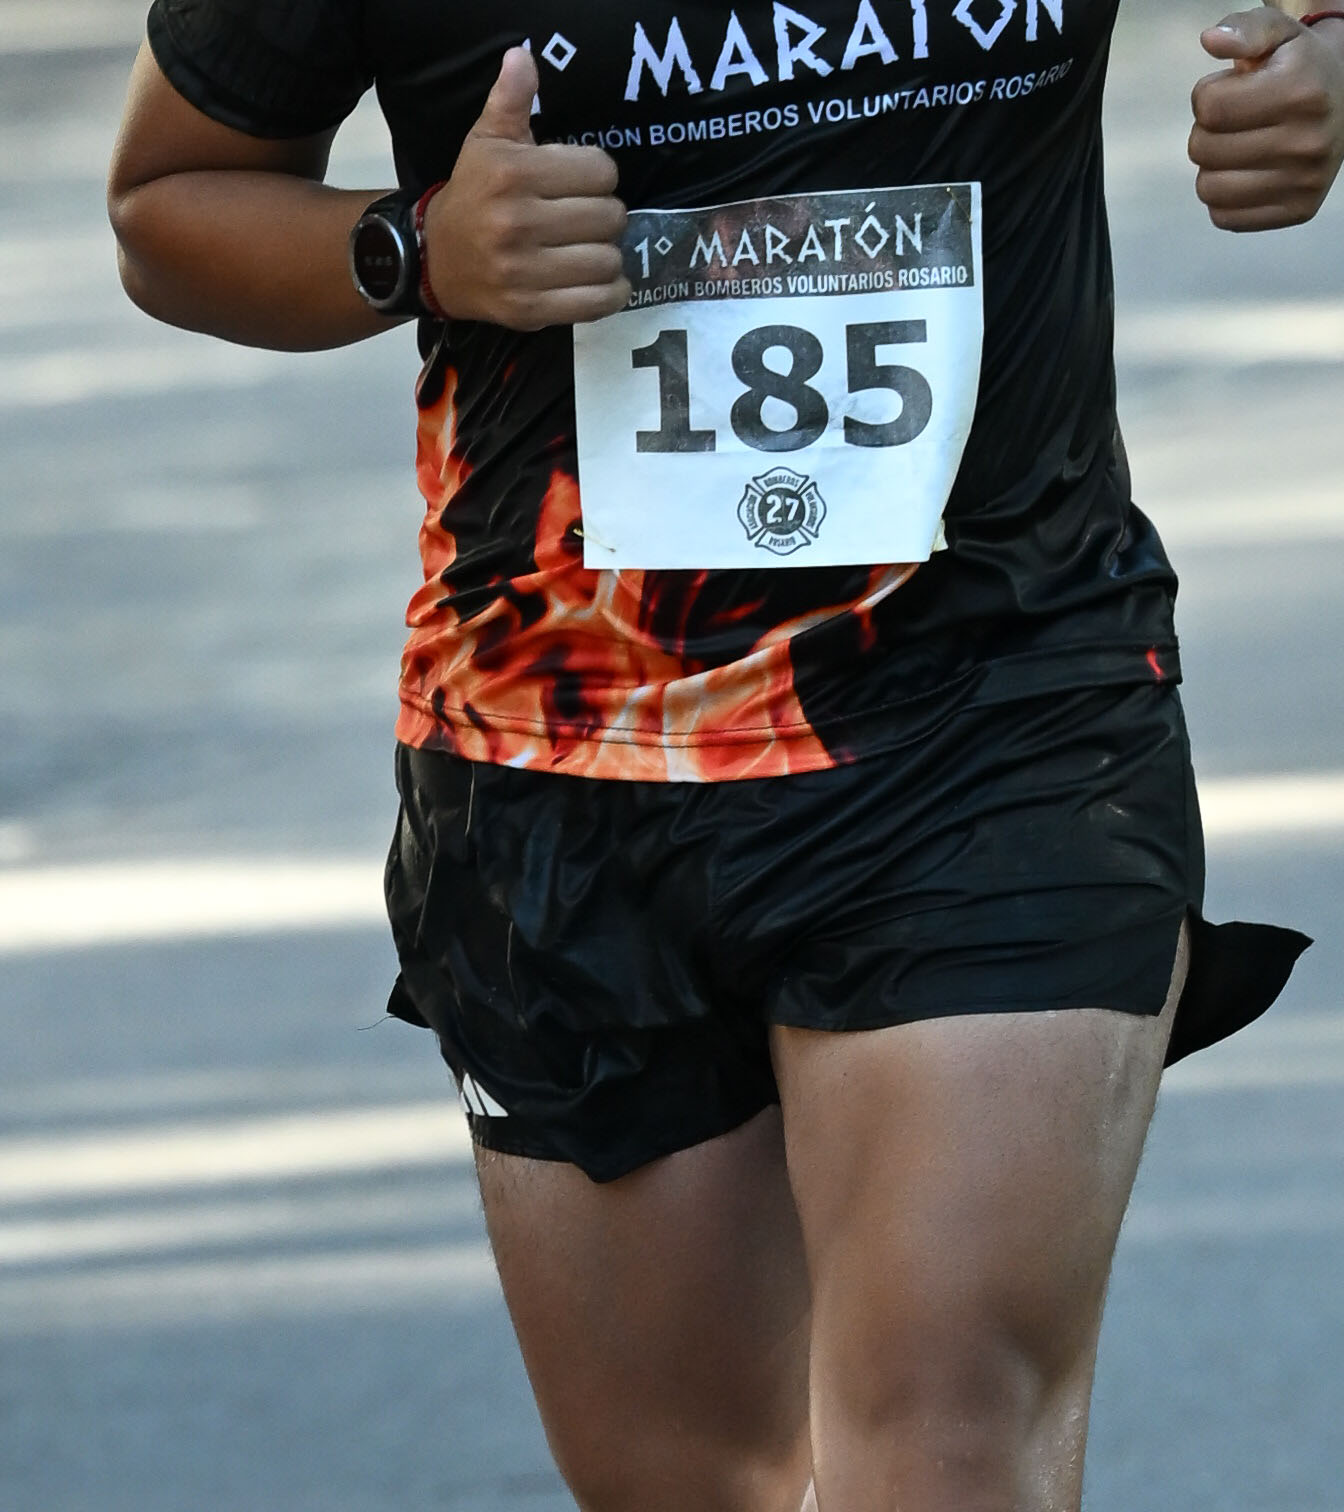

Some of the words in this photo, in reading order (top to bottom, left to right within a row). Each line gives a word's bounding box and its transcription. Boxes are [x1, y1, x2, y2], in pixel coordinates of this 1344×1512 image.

[648, 103, 800, 148] BOMBEROS
[806, 78, 987, 124] VOLUNTARIOS
[988, 56, 1075, 101] ROSARIO
[689, 201, 923, 269] MARATÓN
[694, 276, 783, 299] BOMBEROS
[787, 270, 895, 295] VOLUNTARIOS
[898, 264, 969, 286] ROSARIO
[631, 319, 933, 453] 185
[766, 494, 800, 524] 27
